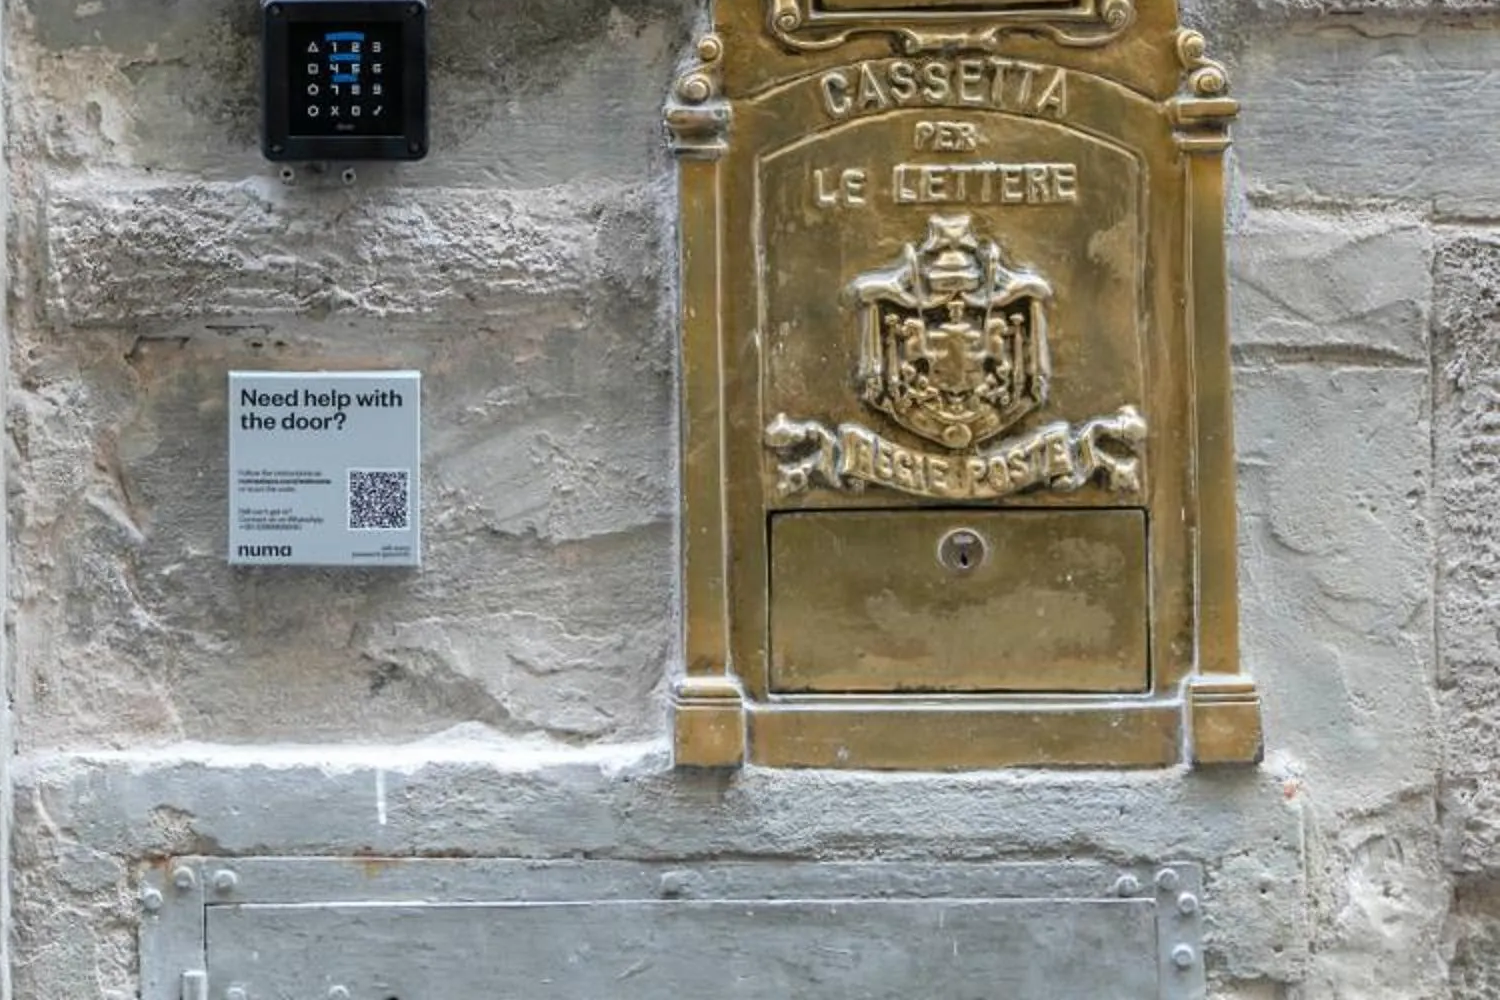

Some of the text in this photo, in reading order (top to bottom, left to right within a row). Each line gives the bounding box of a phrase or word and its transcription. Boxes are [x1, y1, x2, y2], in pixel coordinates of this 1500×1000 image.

[331, 42, 382, 53] 1 2 3
[329, 64, 382, 75] 4 5 6
[330, 84, 382, 96] 7 8 9
[820, 56, 1068, 117] CASSETTA
[351, 105, 361, 116] 0
[914, 121, 980, 150] PER
[813, 163, 1078, 205] LE LETTERE
[240, 389, 403, 410] Need help with
[240, 412, 347, 430] the door?
[852, 436, 1074, 496] REGIE POSTE
[237, 544, 293, 557] numa
